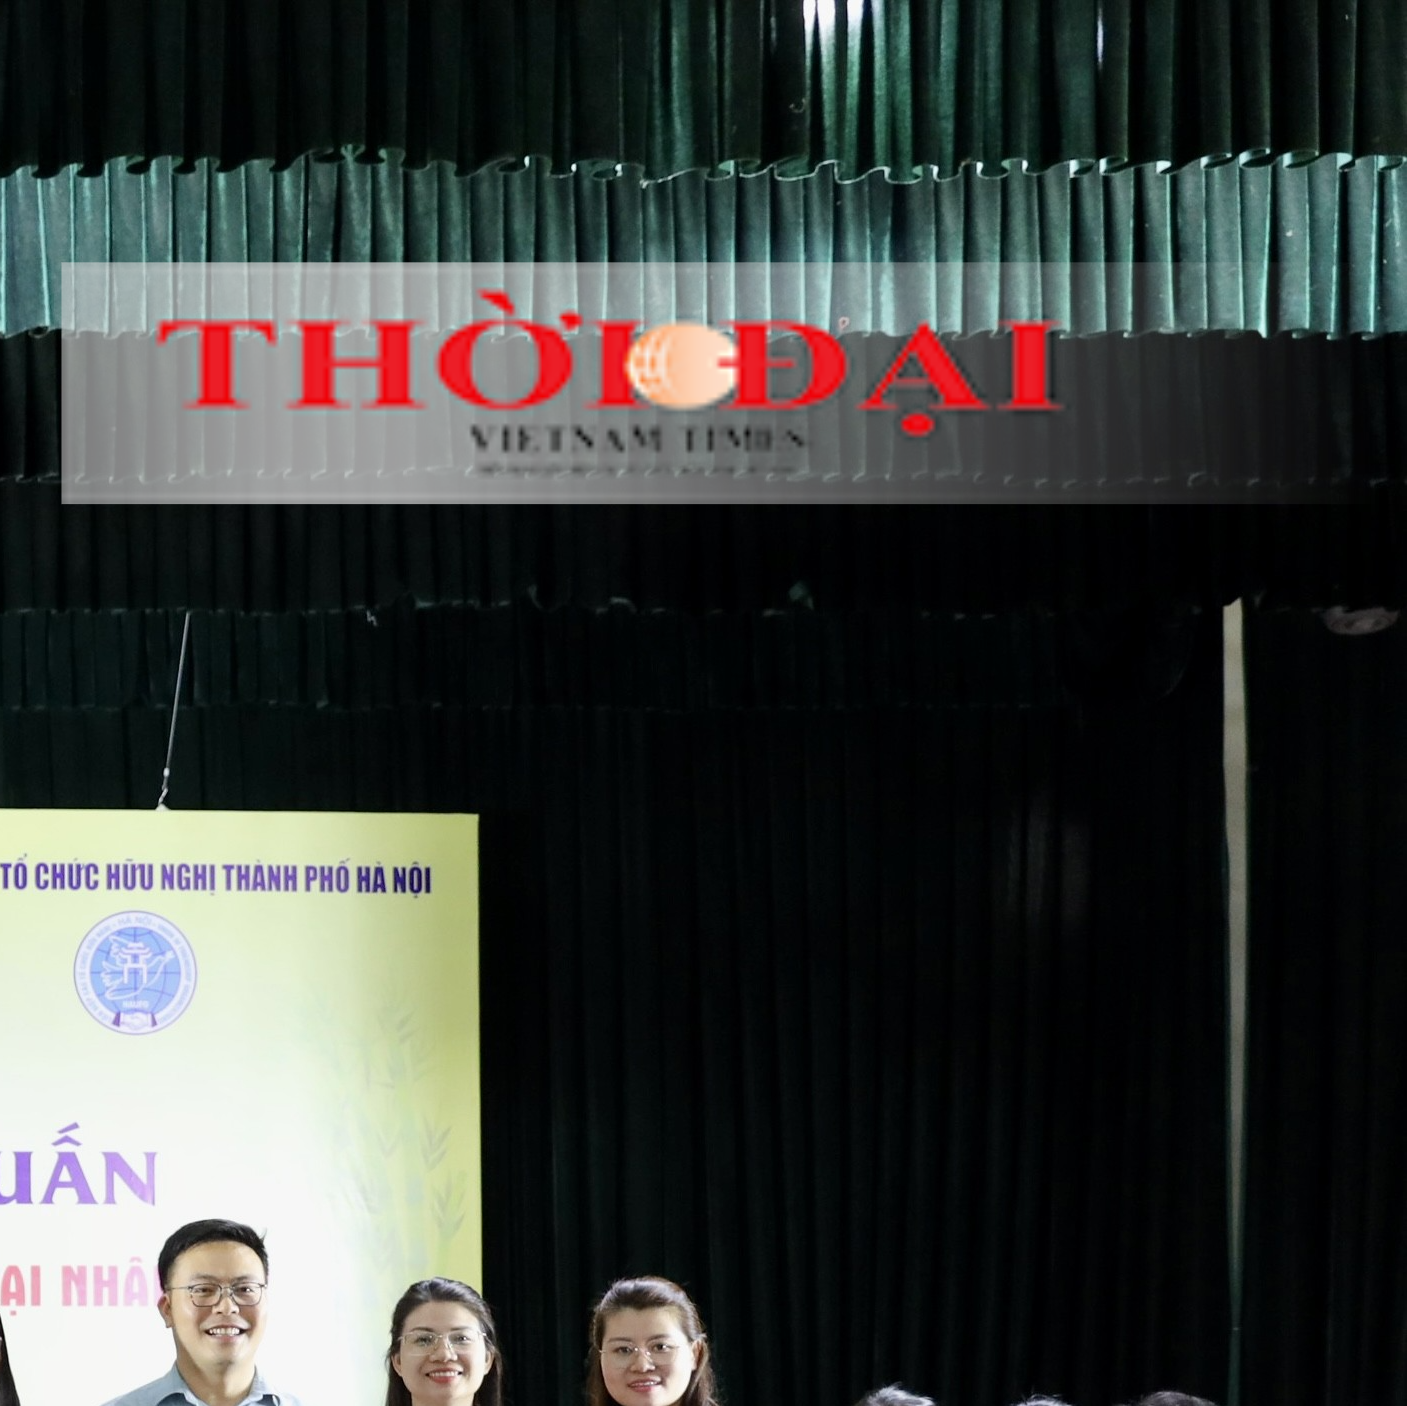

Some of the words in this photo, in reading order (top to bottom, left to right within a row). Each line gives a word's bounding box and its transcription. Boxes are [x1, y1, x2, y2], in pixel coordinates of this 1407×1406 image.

[0, 853, 30, 890] TỔ
[35, 857, 100, 891] CHỨC
[107, 858, 156, 892] HỮU
[161, 863, 217, 897] NGHỊ
[223, 859, 299, 893] THÀNH
[305, 857, 352, 893] PHỐ
[357, 862, 389, 894] HÀ
[394, 861, 433, 898] NỘI
[61, 1257, 162, 1307] NHÂ
